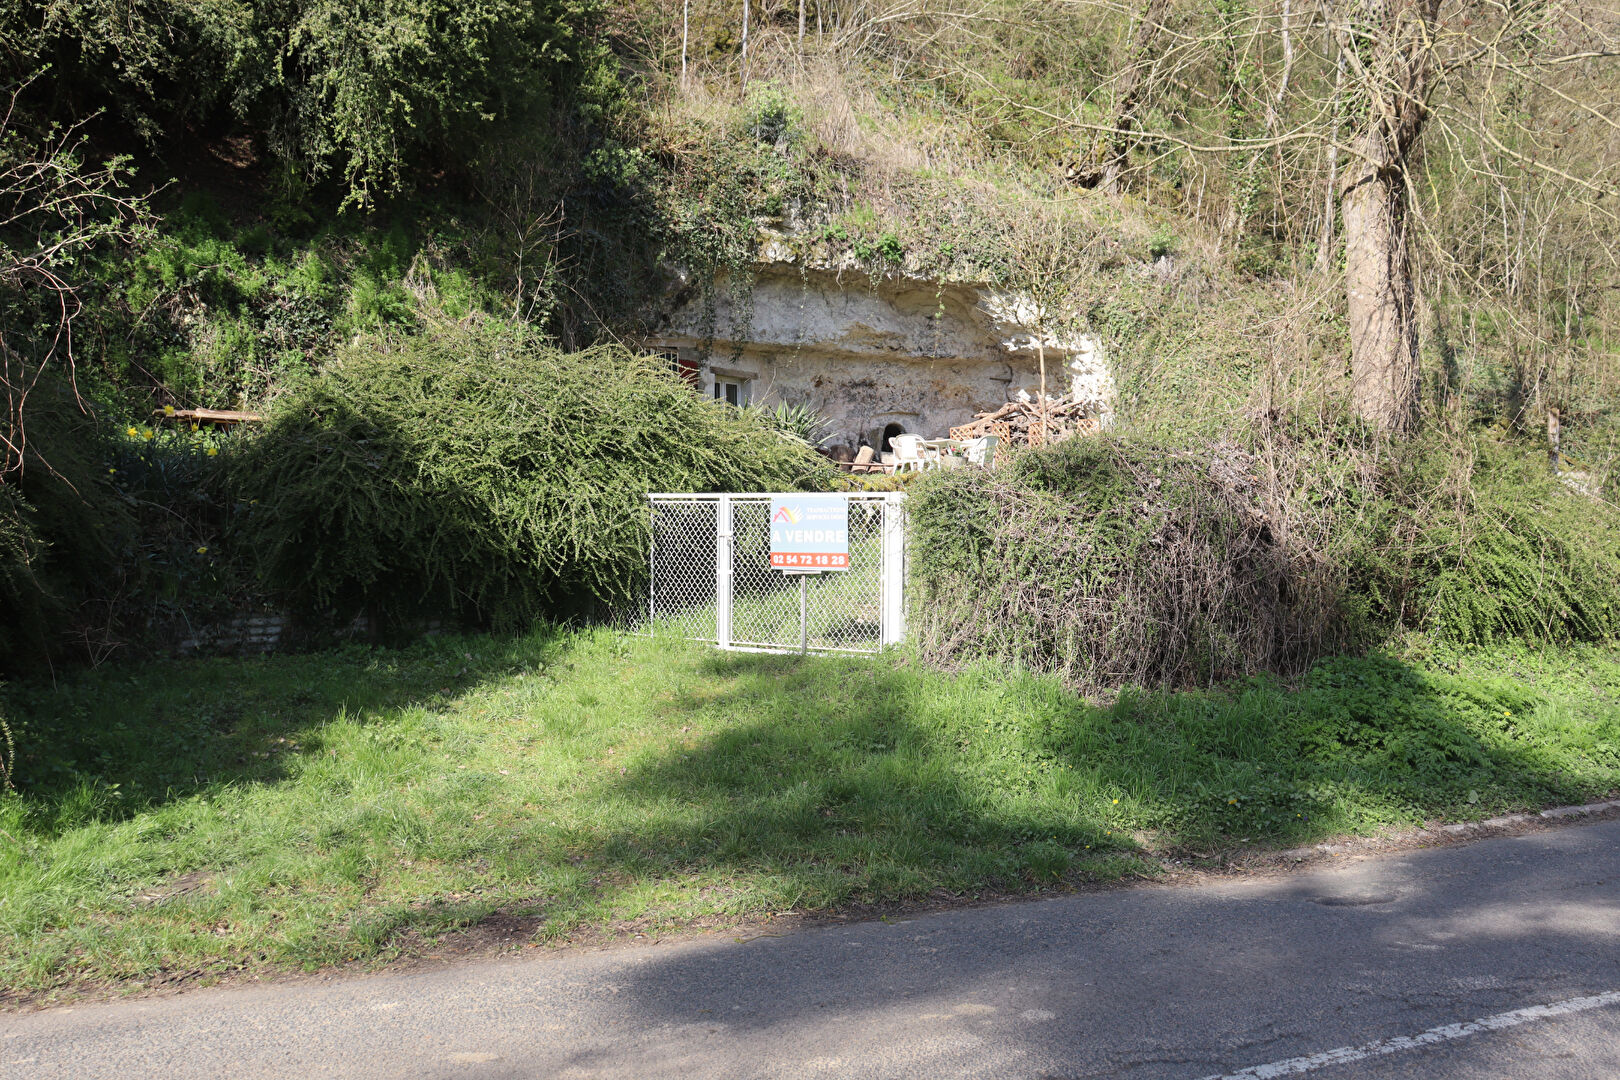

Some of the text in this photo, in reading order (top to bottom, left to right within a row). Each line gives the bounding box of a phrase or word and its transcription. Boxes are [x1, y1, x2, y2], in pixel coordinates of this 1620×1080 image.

[772, 530, 846, 544] A VENDRE
[773, 555, 845, 565] 02 54 72 18 28
